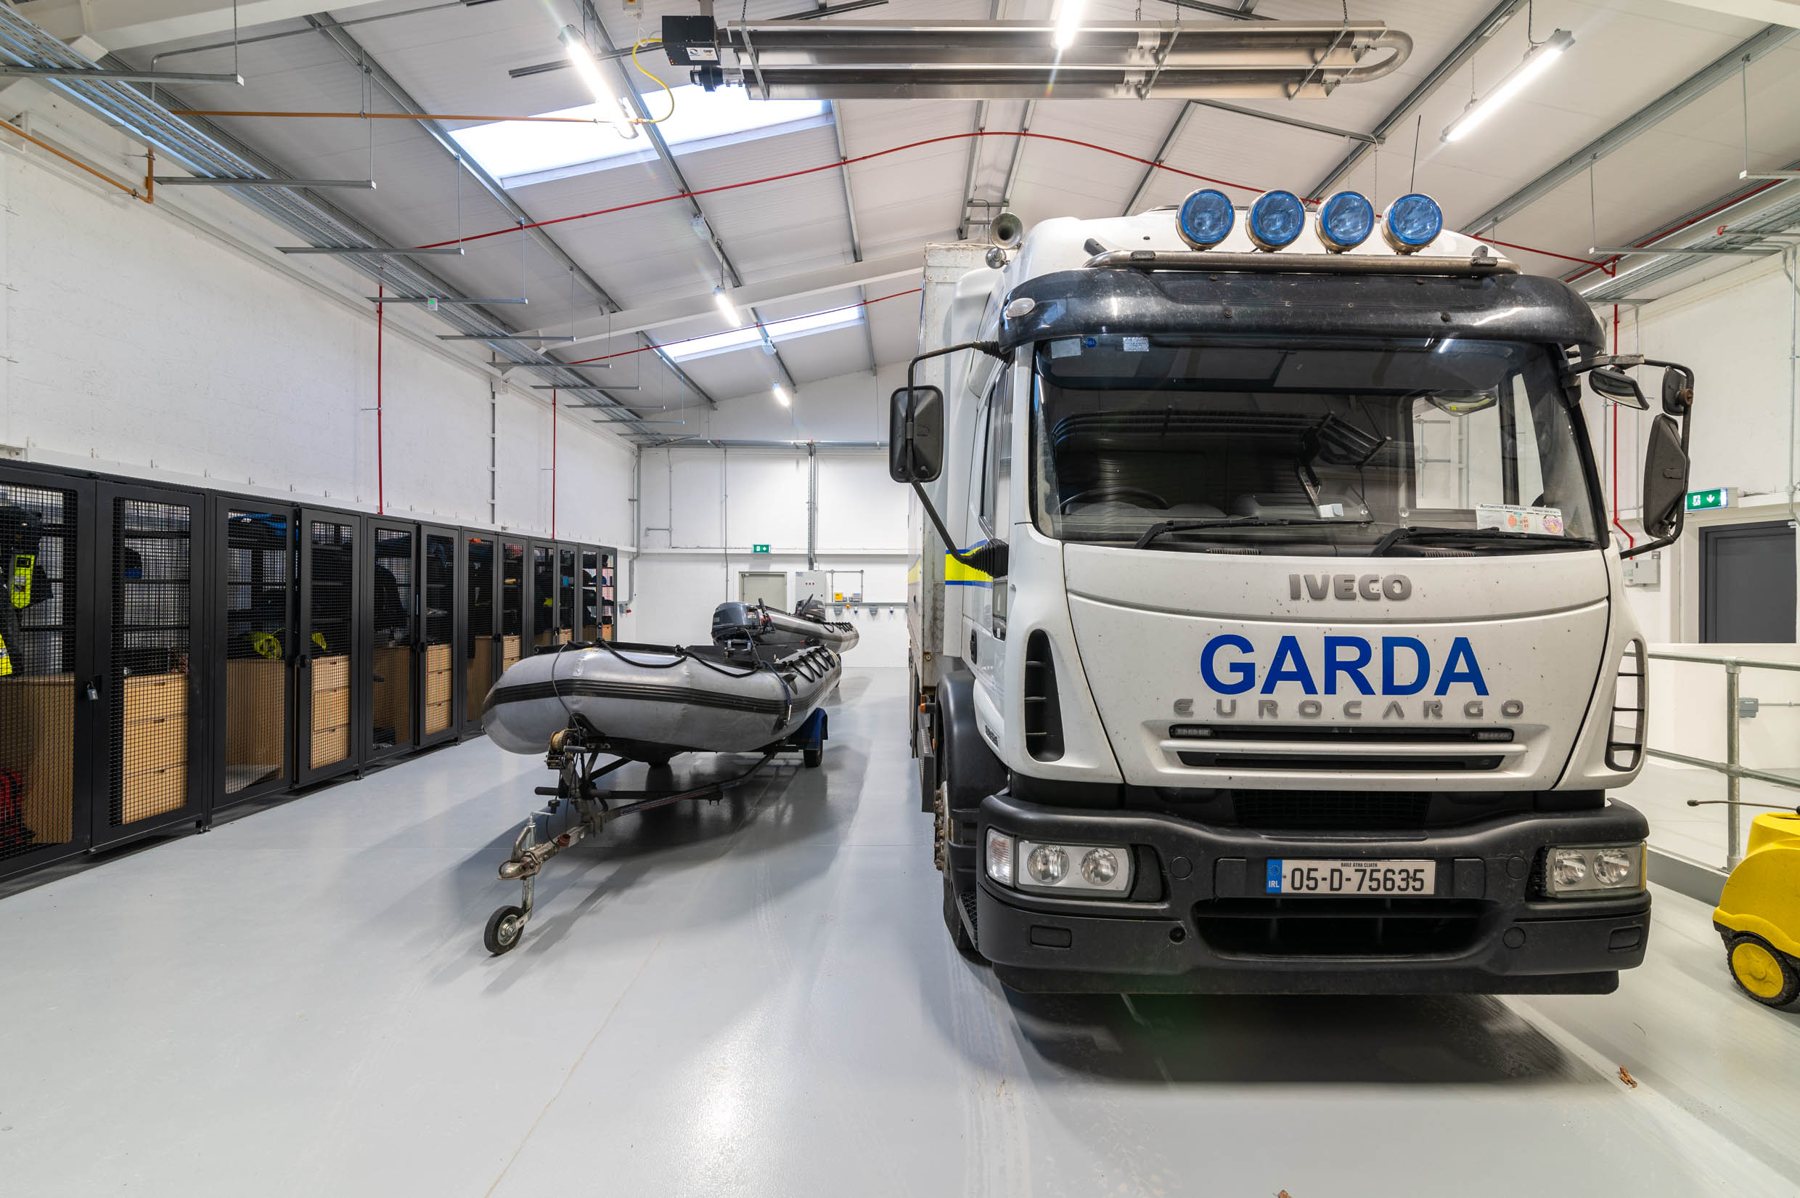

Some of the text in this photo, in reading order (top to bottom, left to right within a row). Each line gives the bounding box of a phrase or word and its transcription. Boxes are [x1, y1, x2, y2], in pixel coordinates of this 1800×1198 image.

[1288, 573, 1412, 601] IVECO
[1200, 633, 1490, 697] GARDA
[1173, 698, 1524, 720] EUROCARGO
[1290, 867, 1425, 892] 05-D-75635
